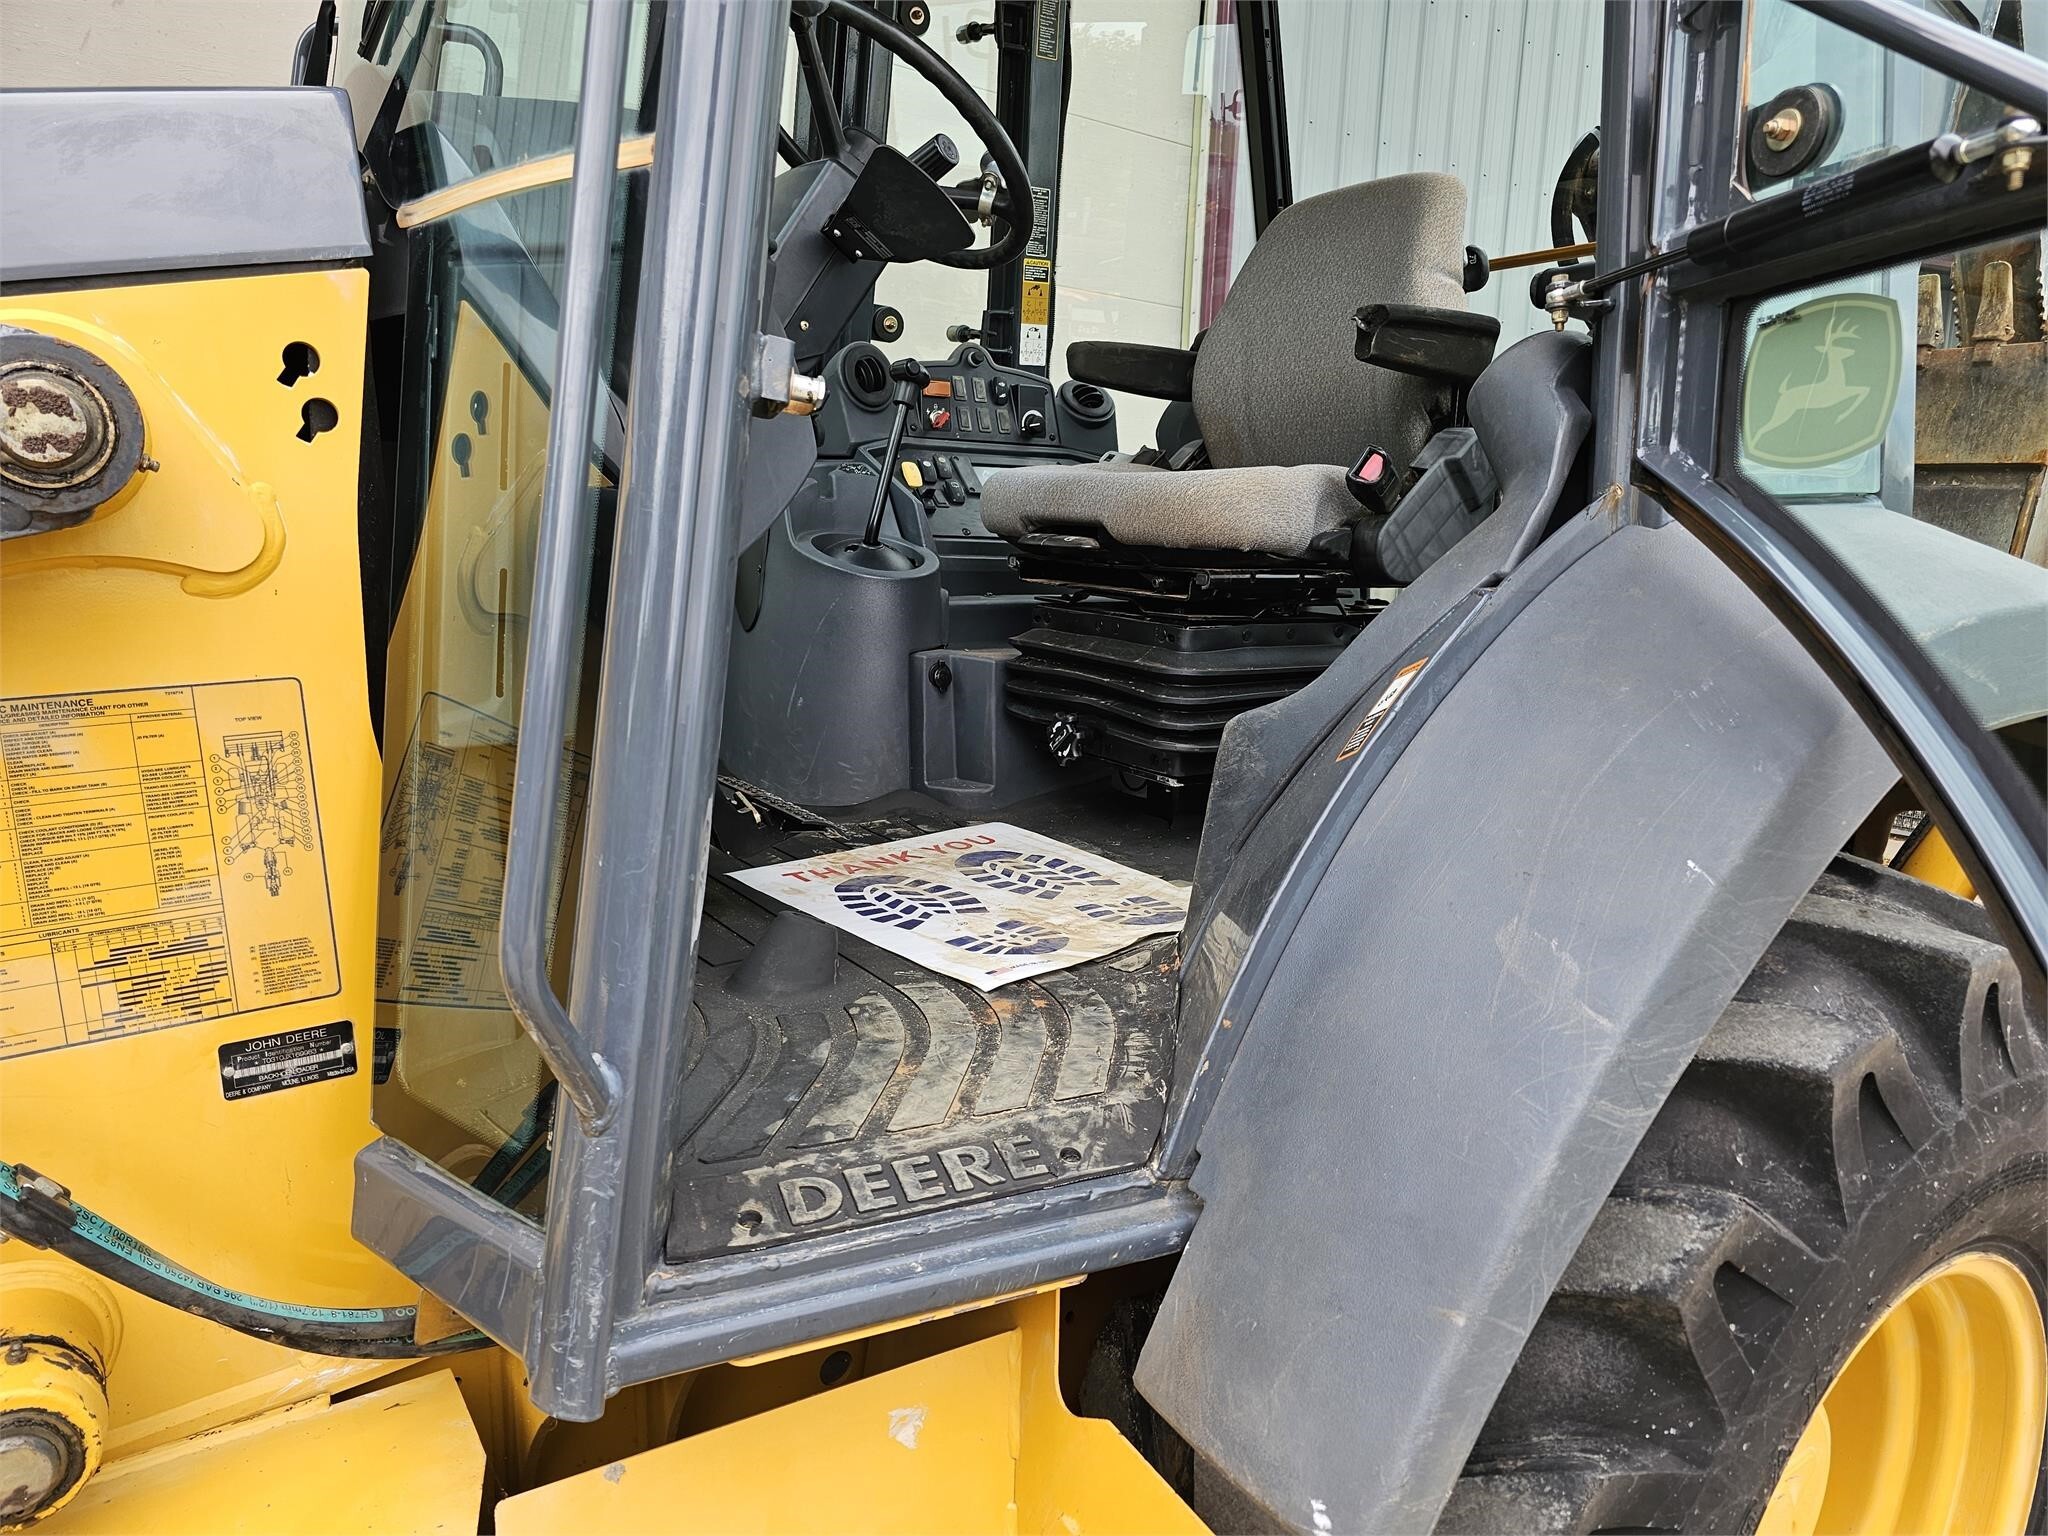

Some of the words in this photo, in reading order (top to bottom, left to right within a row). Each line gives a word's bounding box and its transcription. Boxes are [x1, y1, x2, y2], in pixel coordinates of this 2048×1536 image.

[10, 698, 94, 713] MAINTENANCE
[42, 707, 88, 715] MAINTENANCE
[61, 711, 105, 719] INFORMATION
[782, 850, 925, 882] THANK
[920, 835, 996, 854] YOU
[38, 928, 80, 938] LUBRICANTS
[245, 1037, 281, 1052] JOHN
[286, 1028, 327, 1044] DEERE
[237, 1054, 260, 1064] Product
[265, 1046, 305, 1057] Identification
[309, 1040, 332, 1048] Number
[226, 1090, 241, 1098] DEERE
[247, 1084, 271, 1093] COMPANY
[777, 1135, 1050, 1226] DEERE
[76, 1207, 98, 1224] 2SC
[107, 1226, 153, 1257] 100R16S
[97, 1234, 132, 1256] EN857
[197, 1280, 220, 1296] BAR
[223, 1289, 242, 1302] 295
